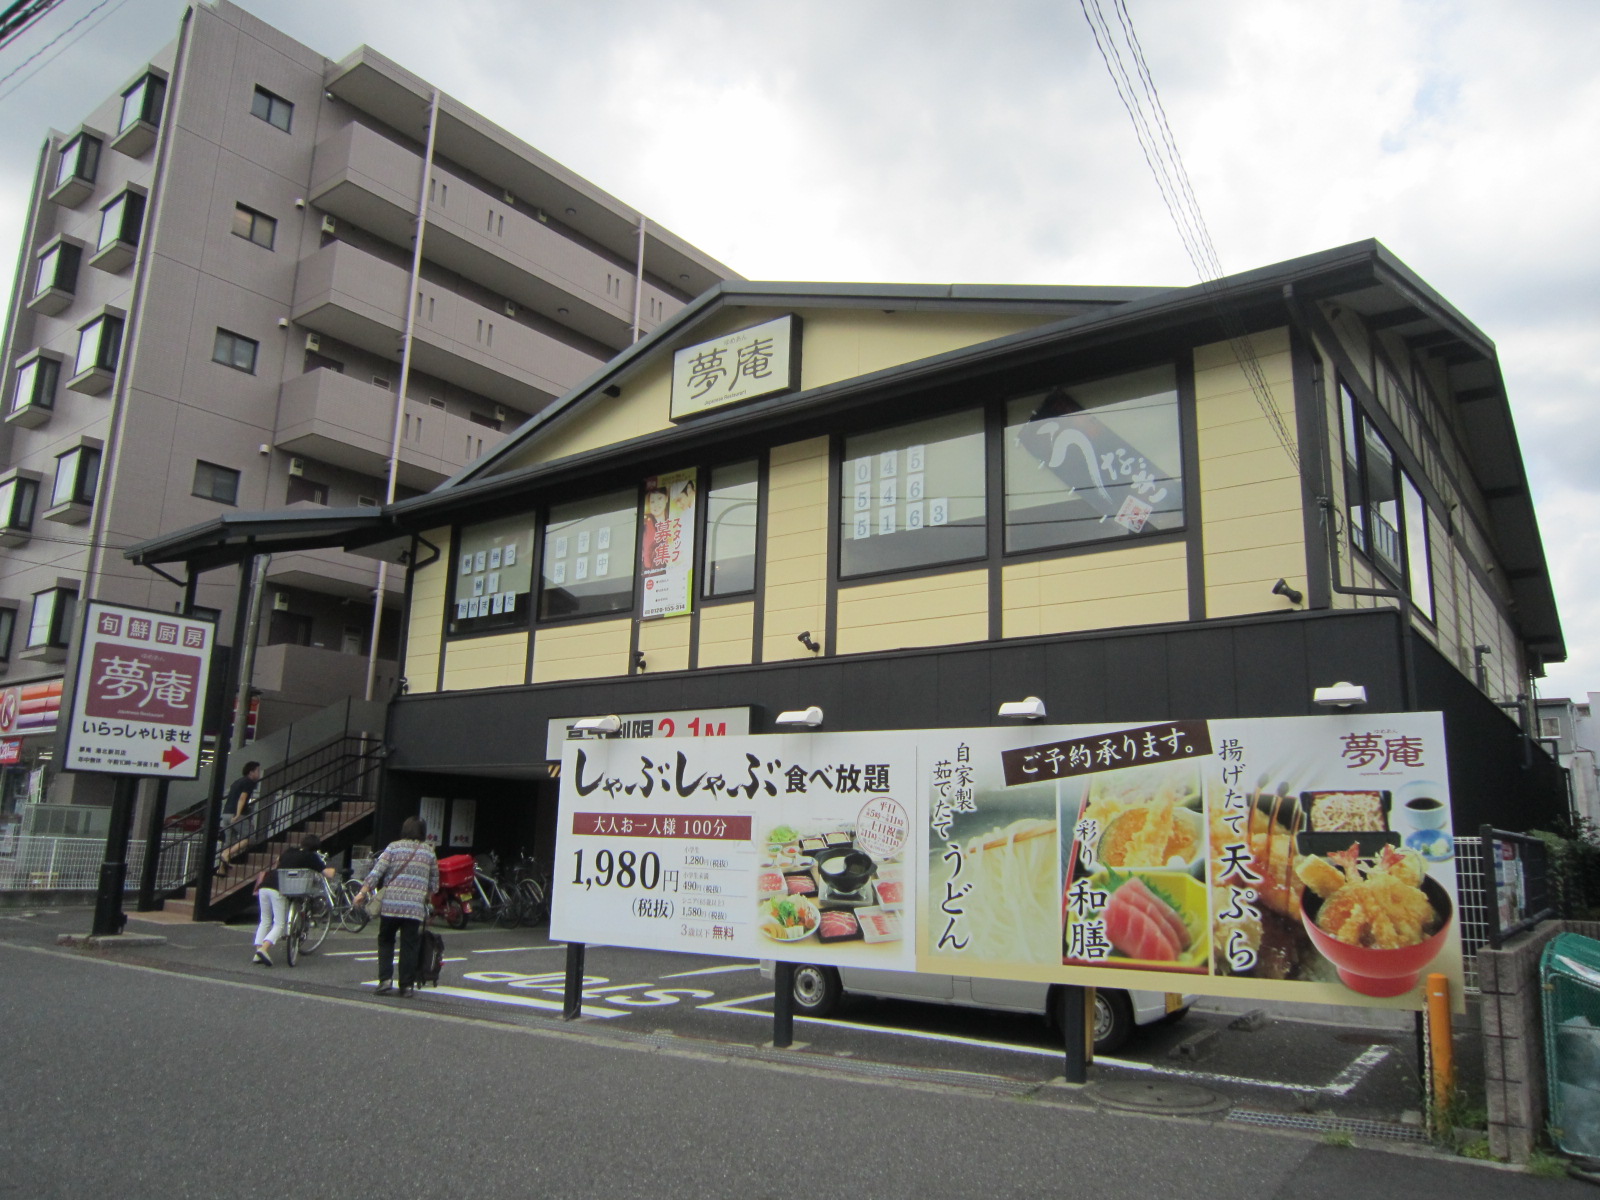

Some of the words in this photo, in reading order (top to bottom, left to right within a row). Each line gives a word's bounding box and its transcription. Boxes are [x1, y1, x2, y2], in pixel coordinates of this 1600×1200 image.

[687, 337, 774, 400] 夢庵
[653, 519, 672, 566] 募集
[672, 518, 682, 562] スタッフ
[99, 613, 204, 648] 旬鮮厨房
[97, 655, 193, 709] 夢庵
[82, 721, 192, 743] いらっしゃいませ
[1021, 727, 1194, 775] ご予約承ります。
[1339, 732, 1425, 771] 夢庵
[933, 760, 953, 838] 茹でたて
[955, 742, 975, 811] 自家製
[593, 816, 677, 835] 大人お一人様
[683, 818, 727, 837] 100分
[1075, 820, 1098, 866] 彩り
[937, 844, 973, 950] うどん
[1068, 880, 1110, 960] 和膳
[712, 925, 735, 941] 無料
